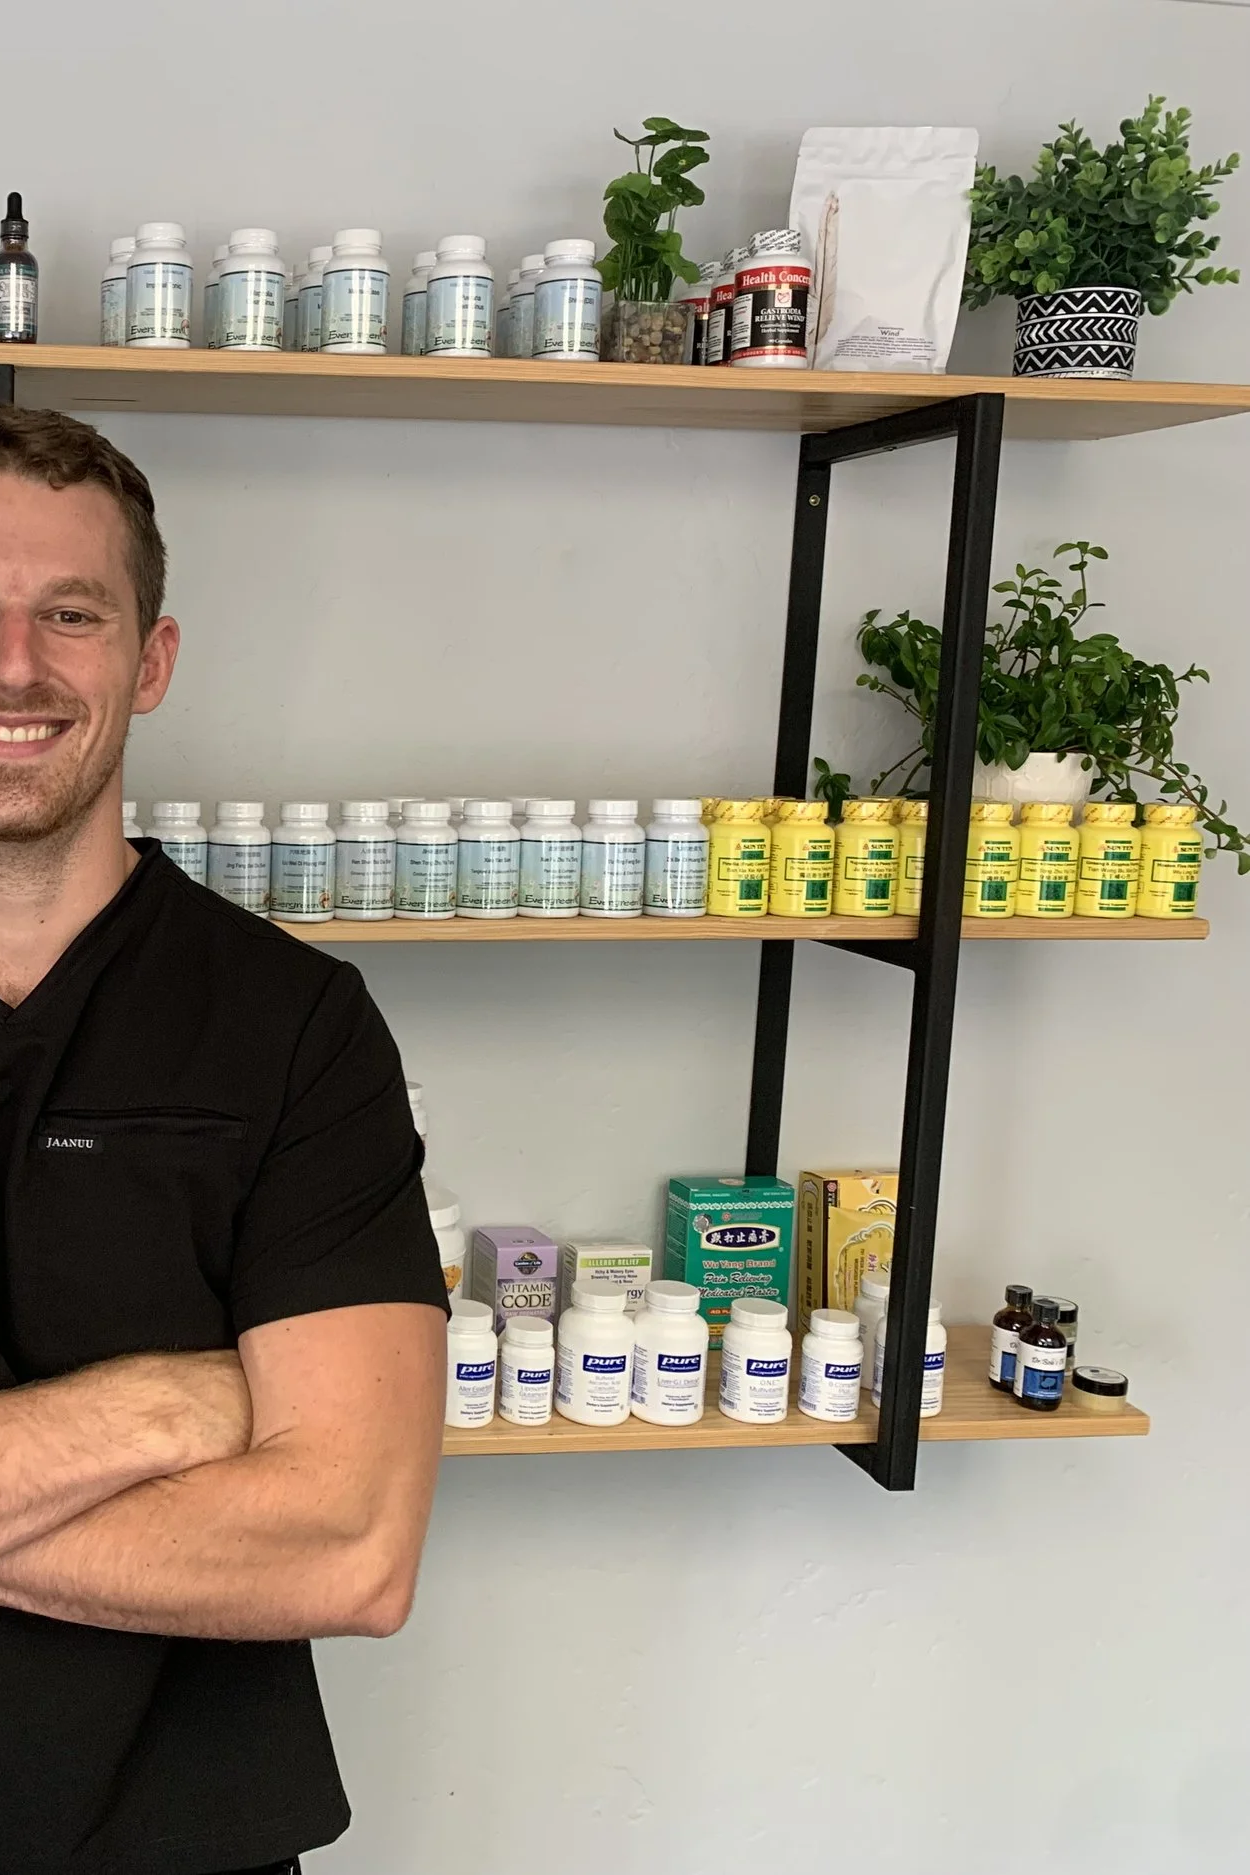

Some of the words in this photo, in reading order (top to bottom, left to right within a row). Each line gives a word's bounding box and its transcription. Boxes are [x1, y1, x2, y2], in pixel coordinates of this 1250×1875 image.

[742, 271, 776, 287] Health
[880, 329, 900, 337] Wind
[45, 1137, 94, 1149] JAANUU
[703, 1272, 729, 1285] Pain
[730, 1271, 773, 1286] Relieving
[502, 1282, 552, 1293] VITAMIN
[501, 1293, 552, 1309] CODE
[586, 1357, 625, 1366] pure
[661, 1357, 699, 1366] pure
[750, 1361, 787, 1370] pure
[460, 1363, 494, 1375] pure
[828, 1365, 860, 1374] pure
[520, 1371, 550, 1379] pure
